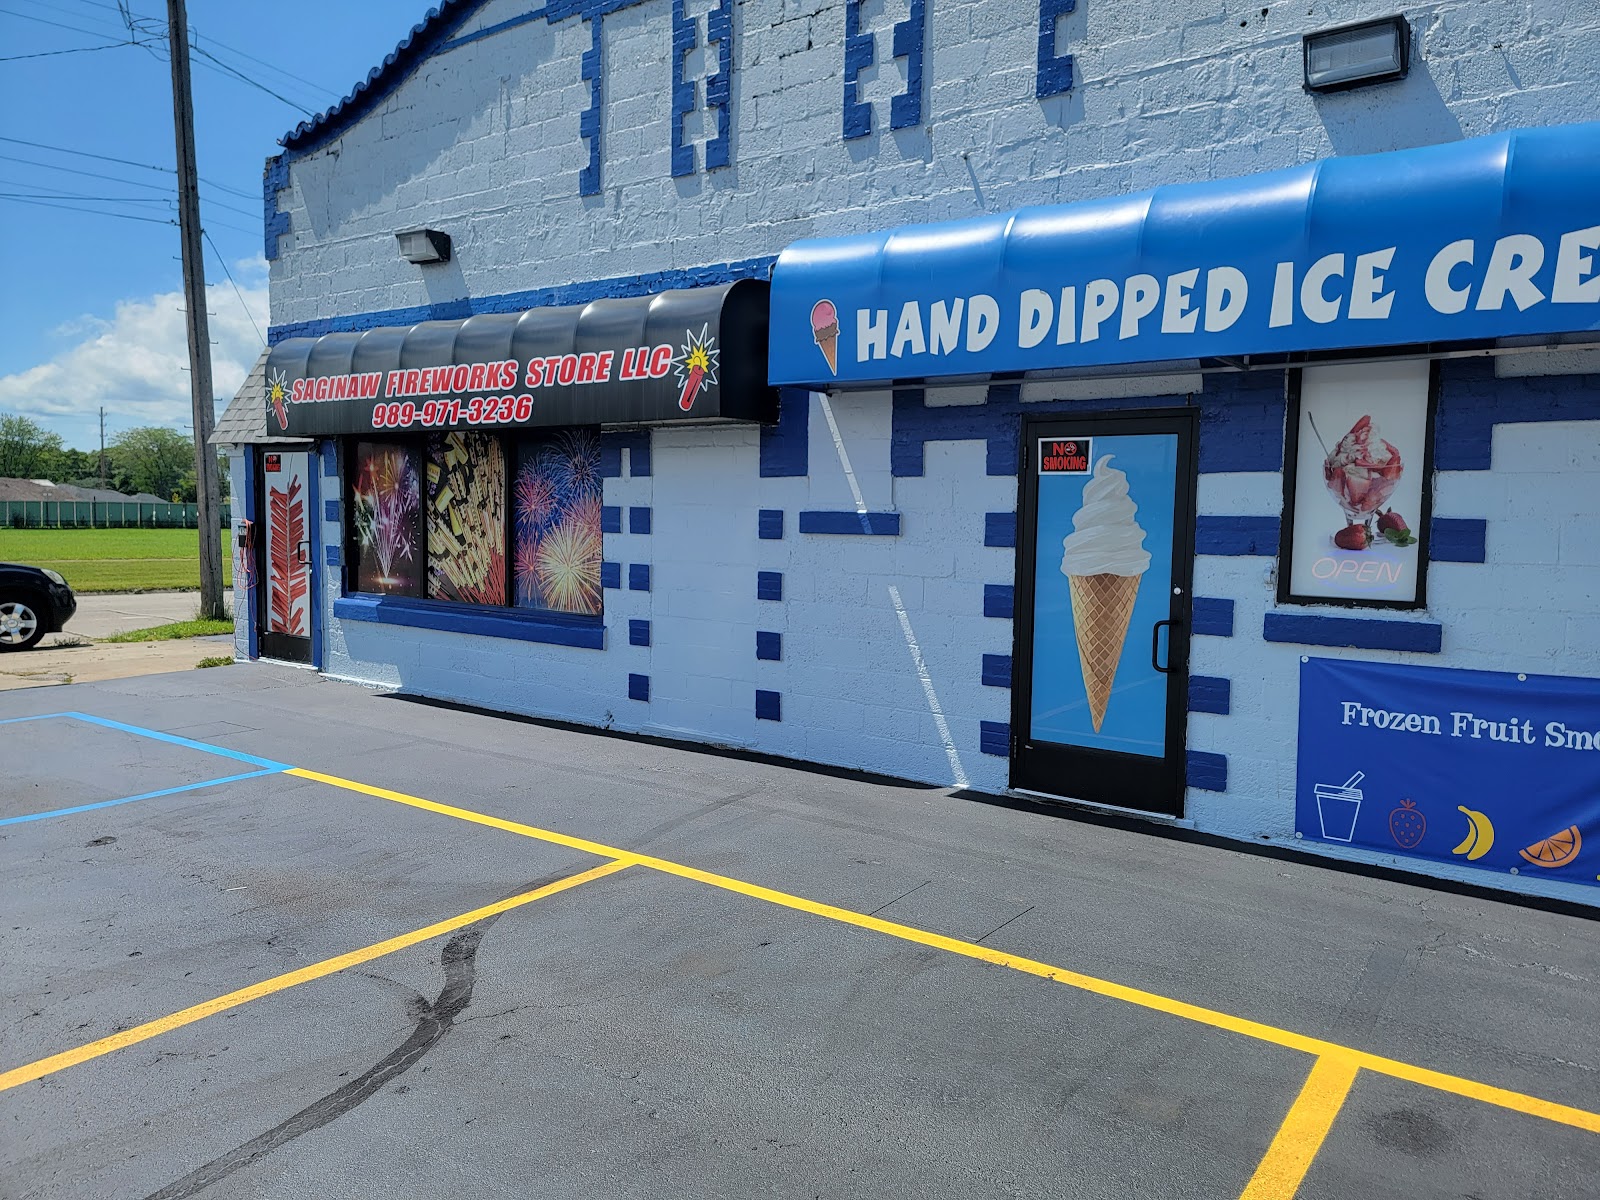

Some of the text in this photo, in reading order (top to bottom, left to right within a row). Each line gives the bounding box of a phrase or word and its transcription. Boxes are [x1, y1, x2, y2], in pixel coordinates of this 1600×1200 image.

[857, 295, 1000, 362] HAND
[1018, 266, 1249, 348] DIPPED
[1269, 246, 1397, 328] ICE
[291, 344, 673, 404] SAGINAW FIREWORKS STORE LLC
[372, 394, 534, 428] 989-971-3236
[1043, 456, 1087, 470] SMOKING
[1053, 442, 1077, 455] NO
[1311, 557, 1403, 583] OPEN
[1340, 702, 1441, 735] Frozen
[1450, 712, 1536, 745] Fruit
